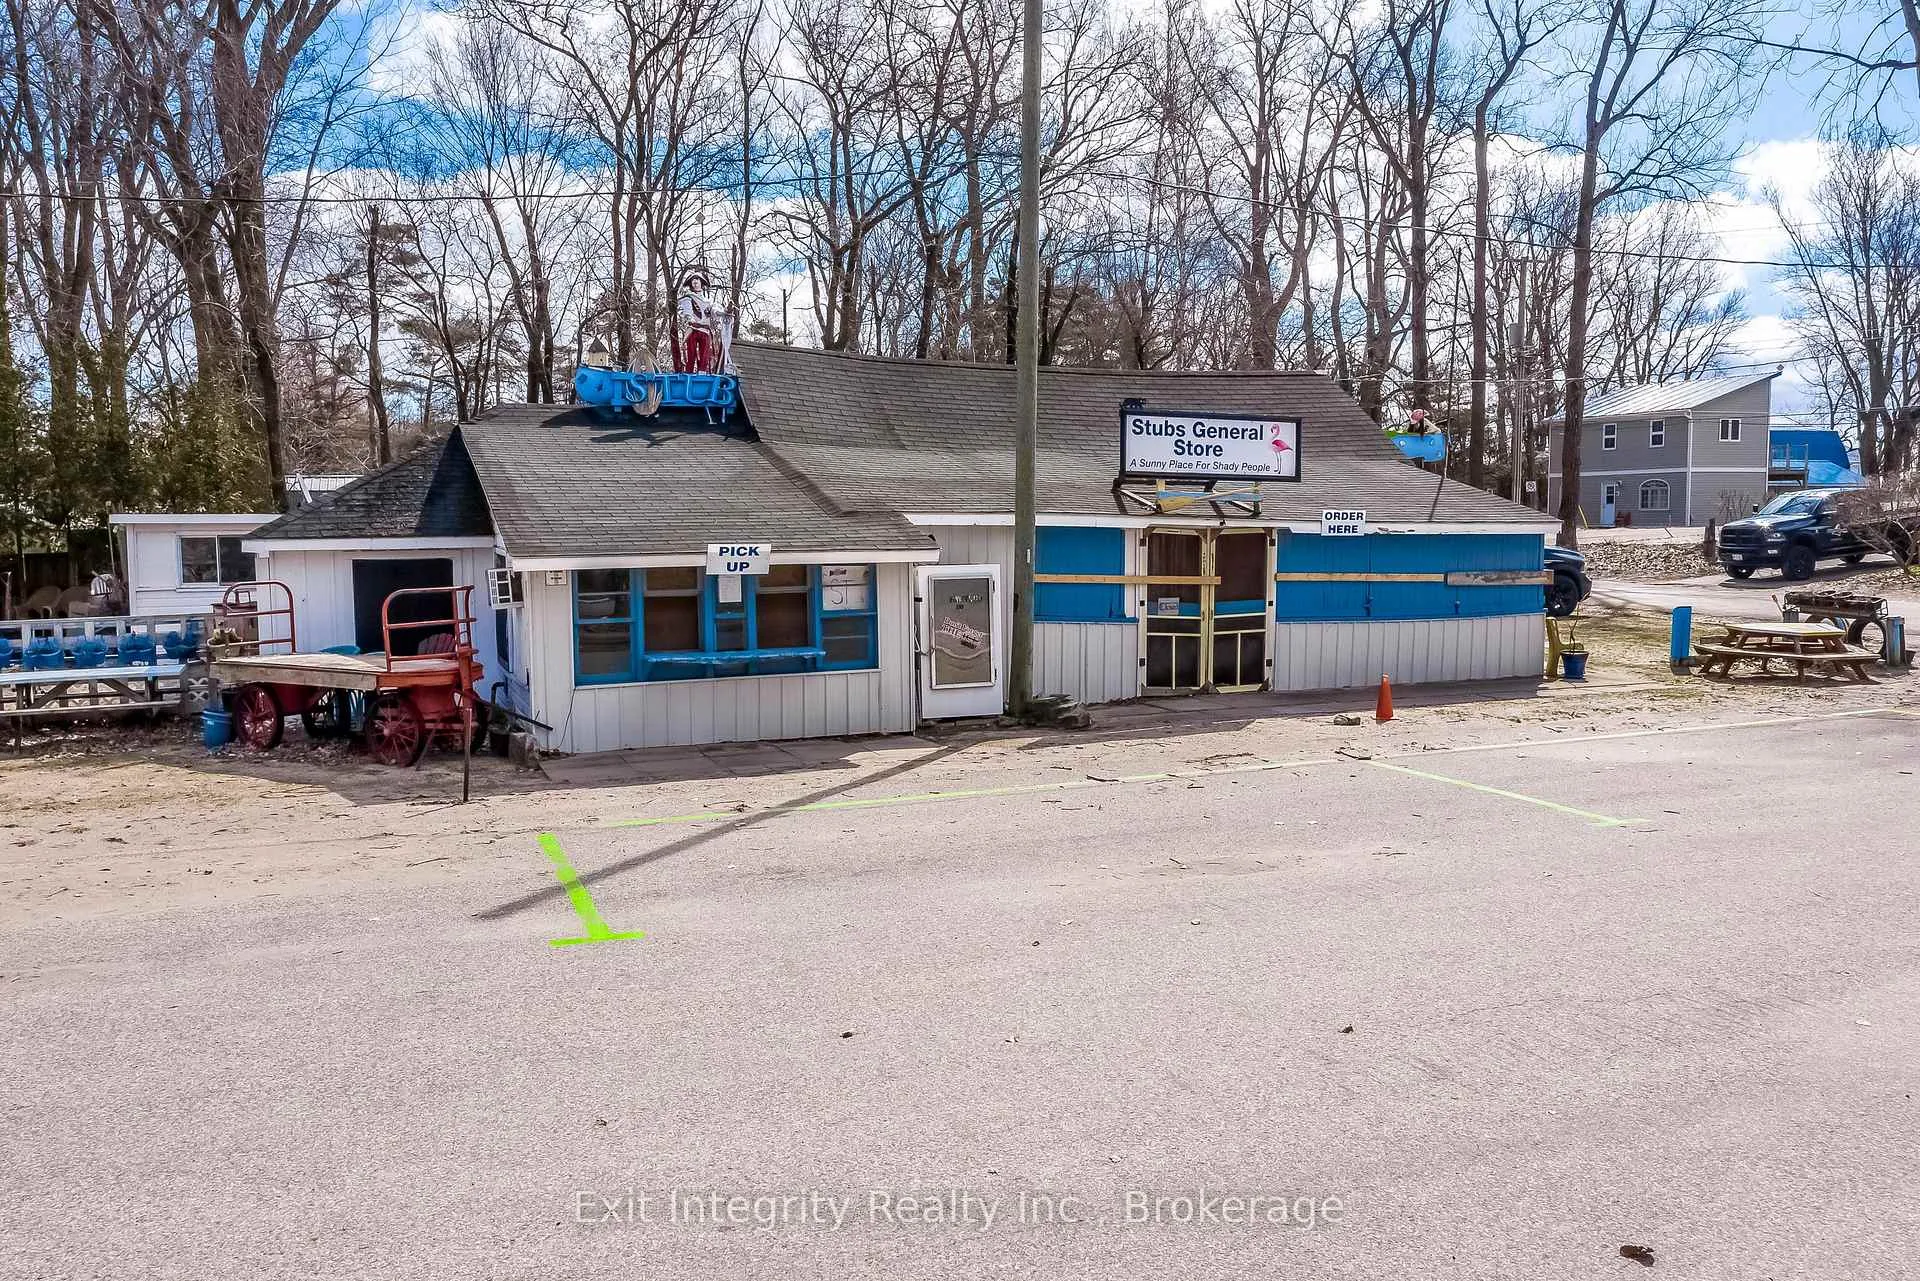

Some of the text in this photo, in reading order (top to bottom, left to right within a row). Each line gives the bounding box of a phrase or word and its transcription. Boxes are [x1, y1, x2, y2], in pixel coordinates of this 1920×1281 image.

[1132, 419, 1264, 441] Stubs General
[1173, 439, 1223, 457] Store
[1129, 458, 1271, 473] A Sunny Place For Shady People
[1324, 511, 1364, 521] ORDER
[1328, 524, 1359, 534] HERE
[718, 546, 760, 557] PICK
[726, 561, 750, 572] UP
